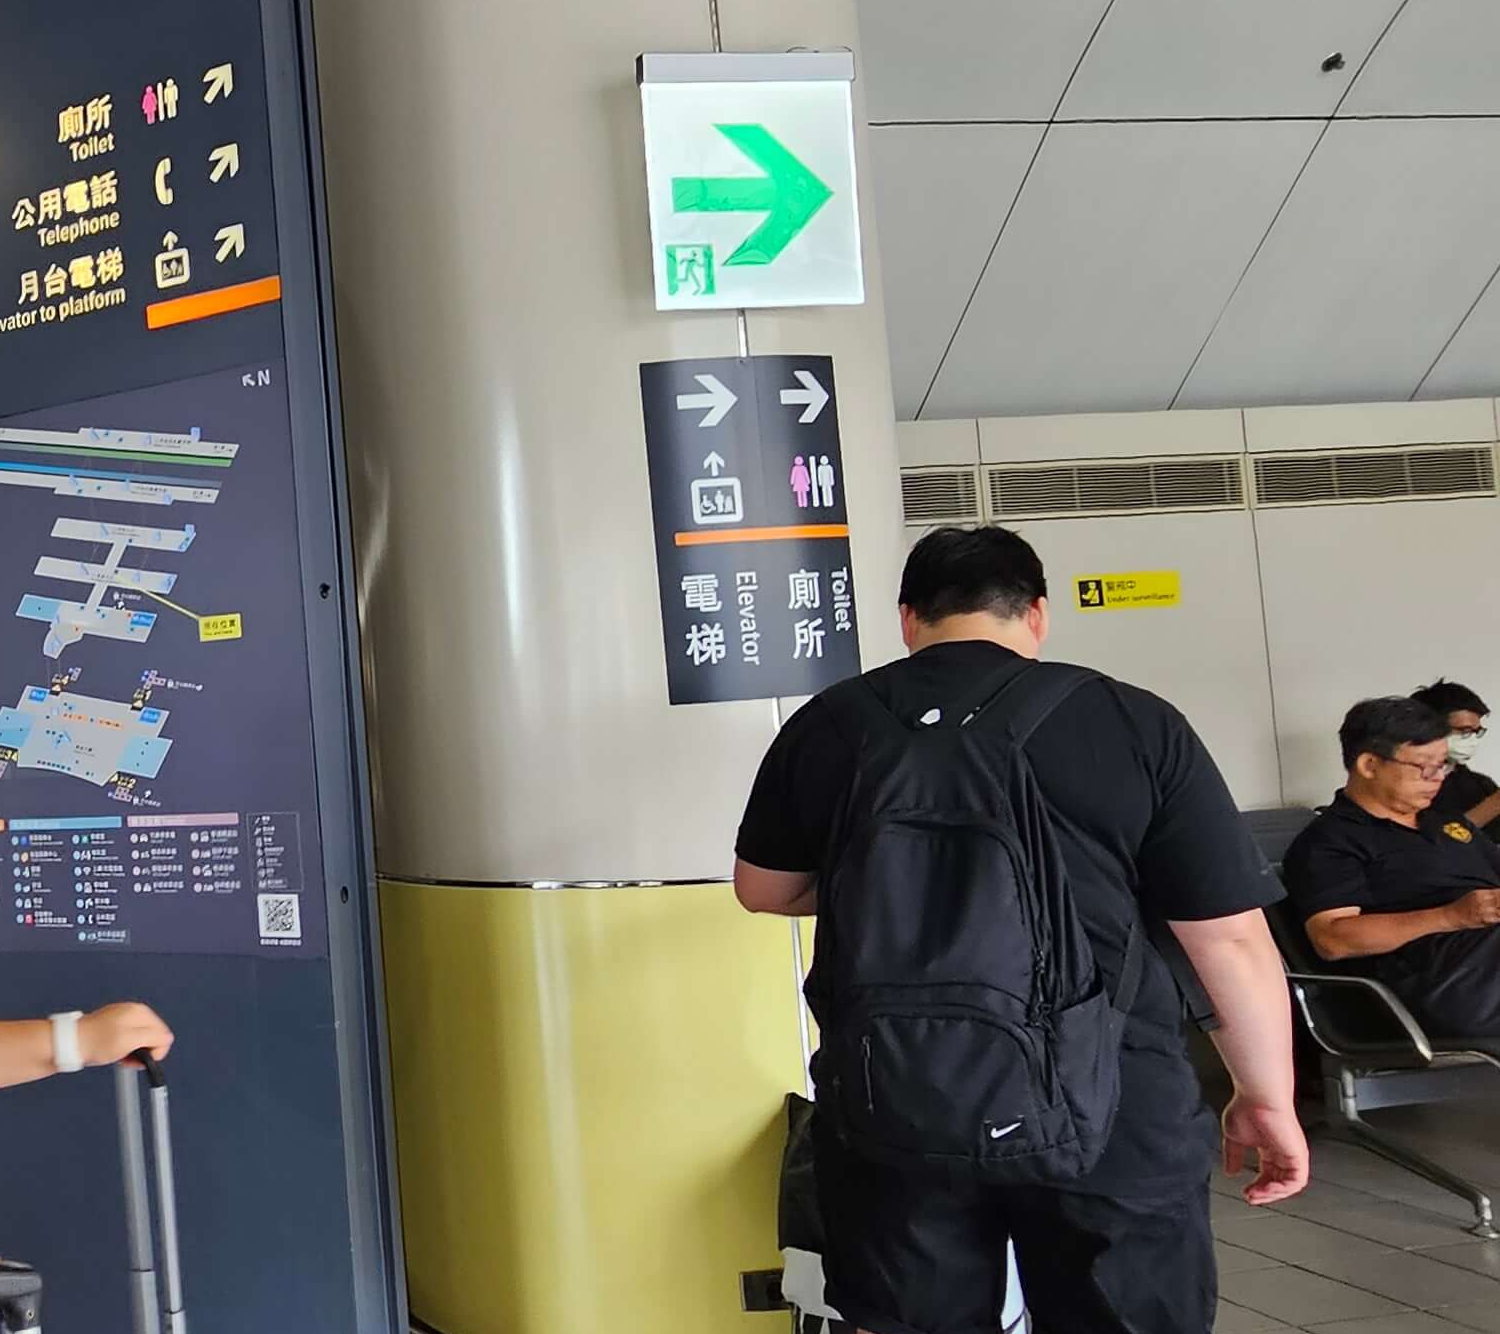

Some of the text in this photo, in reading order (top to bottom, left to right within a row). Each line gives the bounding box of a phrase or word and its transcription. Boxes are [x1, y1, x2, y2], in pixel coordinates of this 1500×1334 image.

[58, 95, 112, 143] 廁所
[69, 133, 115, 162] Toilet
[12, 171, 117, 230] 公用電話
[37, 212, 120, 247] Telephone
[18, 246, 124, 304] 月台電梯
[39, 305, 56, 323] to
[59, 288, 126, 321] platform
[257, 369, 271, 386] N
[681, 573, 726, 666] 電梯
[736, 571, 760, 666] Elevator
[788, 569, 826, 660] 廁所
[831, 567, 852, 632] Toilet
